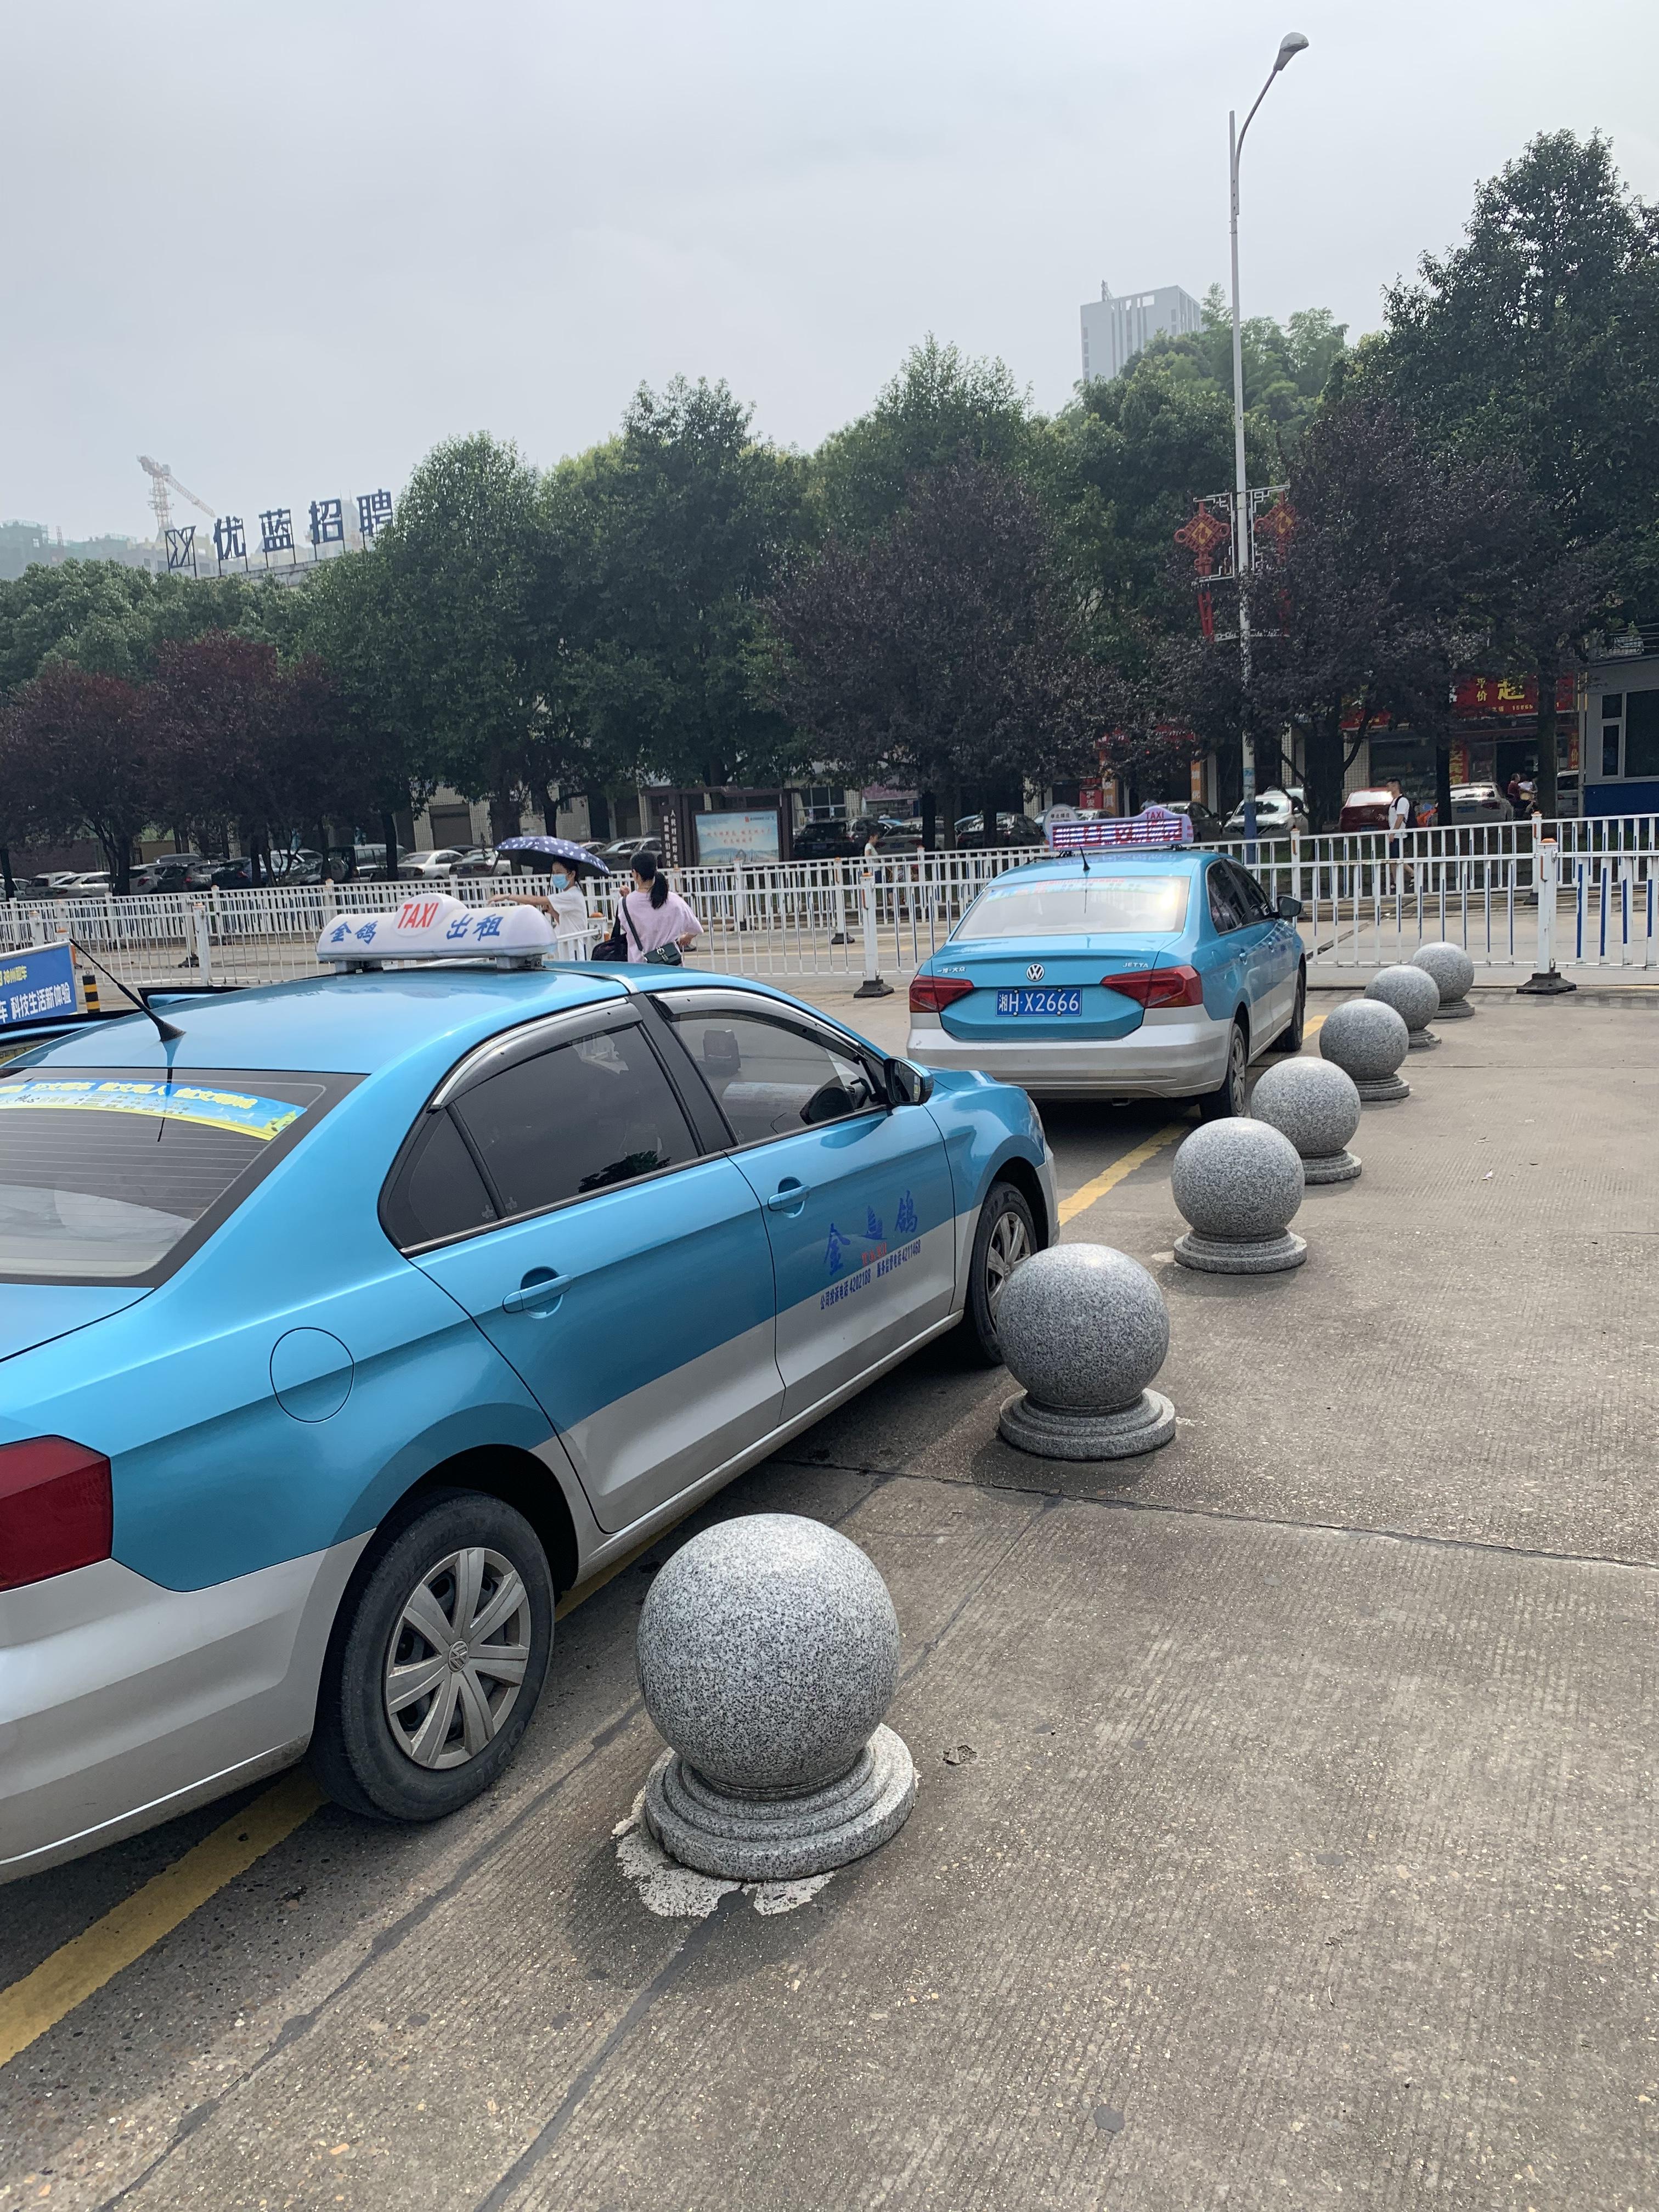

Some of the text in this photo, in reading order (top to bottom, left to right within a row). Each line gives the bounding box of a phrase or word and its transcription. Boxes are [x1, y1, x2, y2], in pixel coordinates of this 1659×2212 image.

[213, 488, 393, 560] 优蓝招聘
[1146, 811, 1165, 820] TAXI
[330, 913, 504, 945] 金鸽 出租
[398, 902, 439, 929] TAXI
[10, 982, 71, 1020] 科技生活新体验
[998, 992, 1079, 1013] 湘H·X2666
[877, 1249, 901, 1278] 服务监督电话
[820, 1280, 848, 1311] 公司投诉电话
